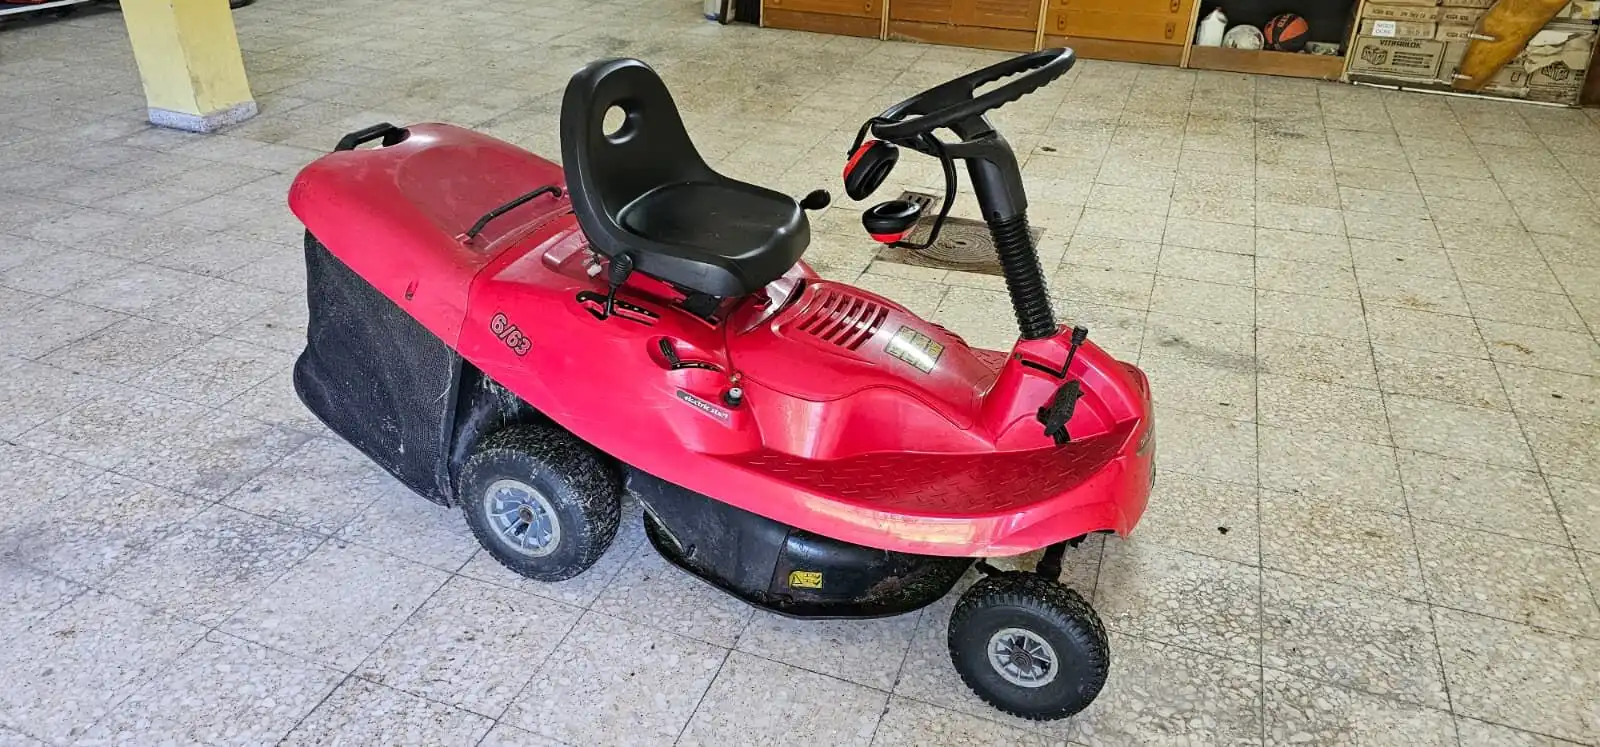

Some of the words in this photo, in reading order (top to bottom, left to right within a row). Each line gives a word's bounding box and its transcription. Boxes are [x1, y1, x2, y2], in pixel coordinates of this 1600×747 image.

[490, 312, 532, 356] 6/63
[684, 395, 711, 411] electric
[710, 408, 729, 419] start
